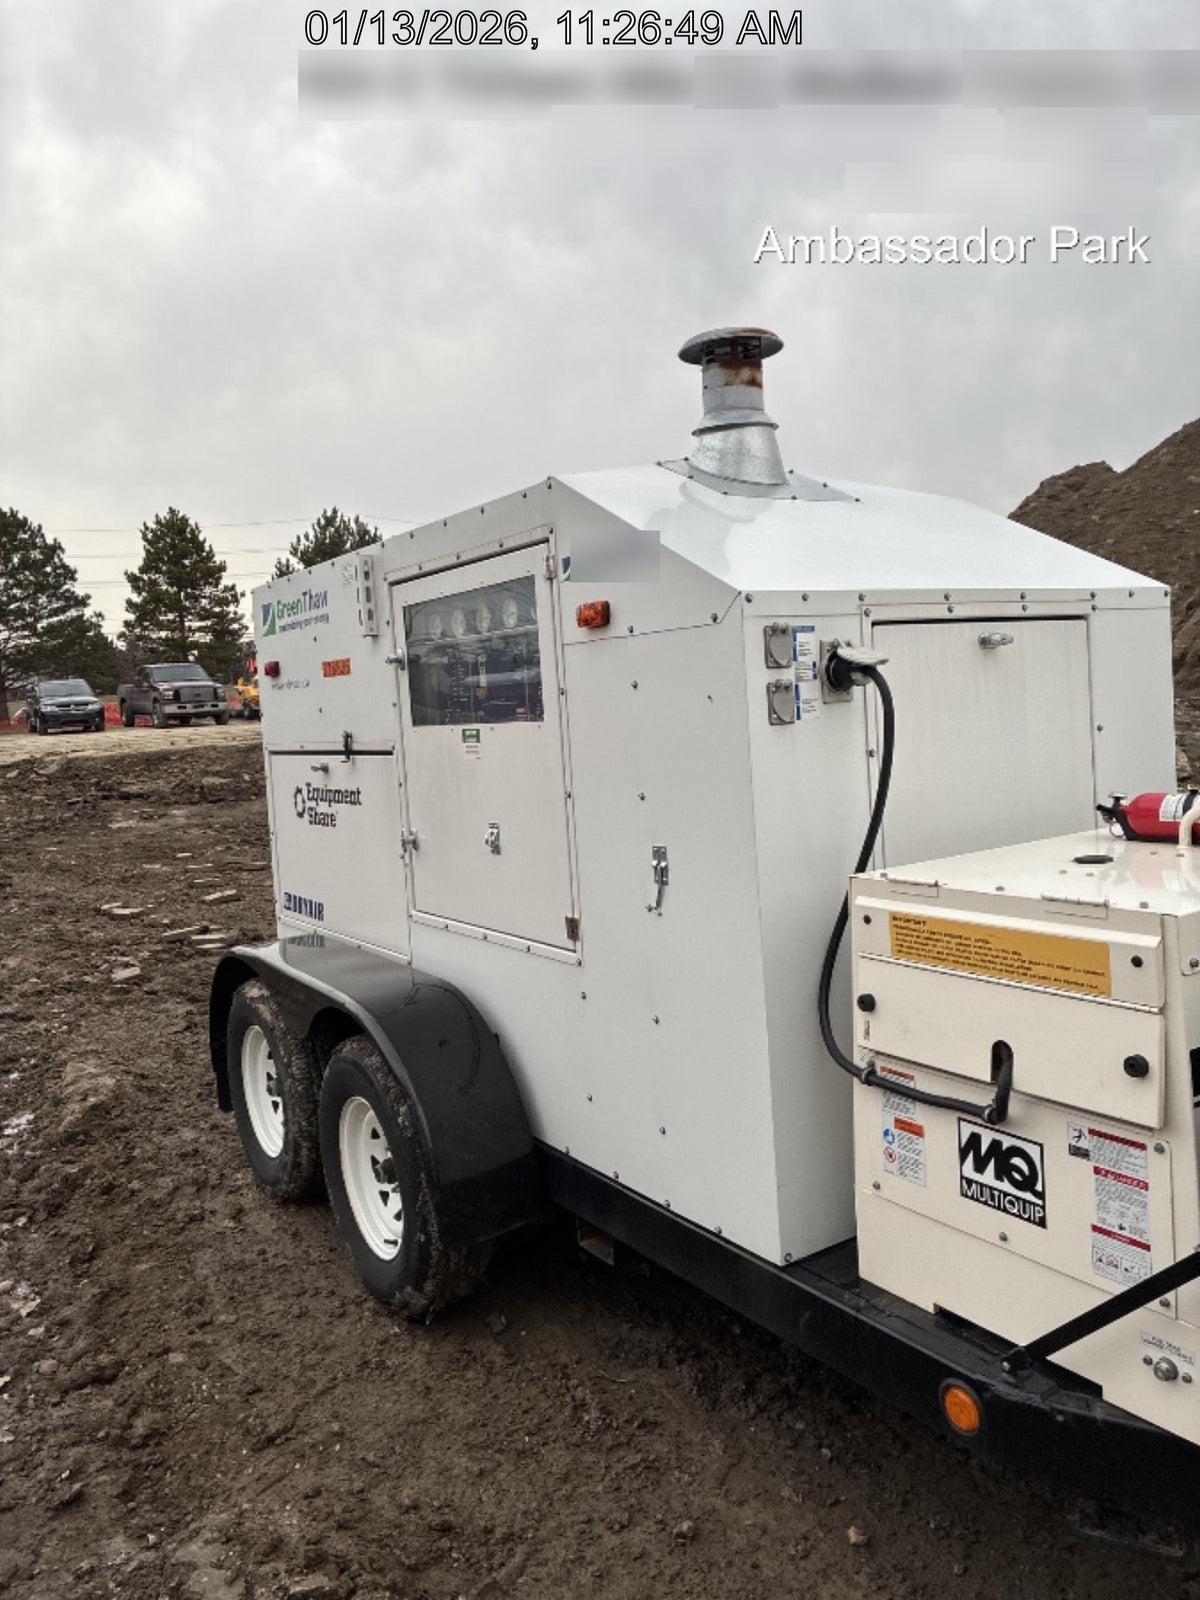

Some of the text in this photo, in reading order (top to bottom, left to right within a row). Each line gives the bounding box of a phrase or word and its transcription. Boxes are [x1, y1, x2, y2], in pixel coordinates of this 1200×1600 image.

[305, 782, 362, 807] Equipment
[307, 807, 337, 828] Share
[960, 1131, 1043, 1199] MQ
[961, 1178, 1044, 1223] MULTIQUIP
